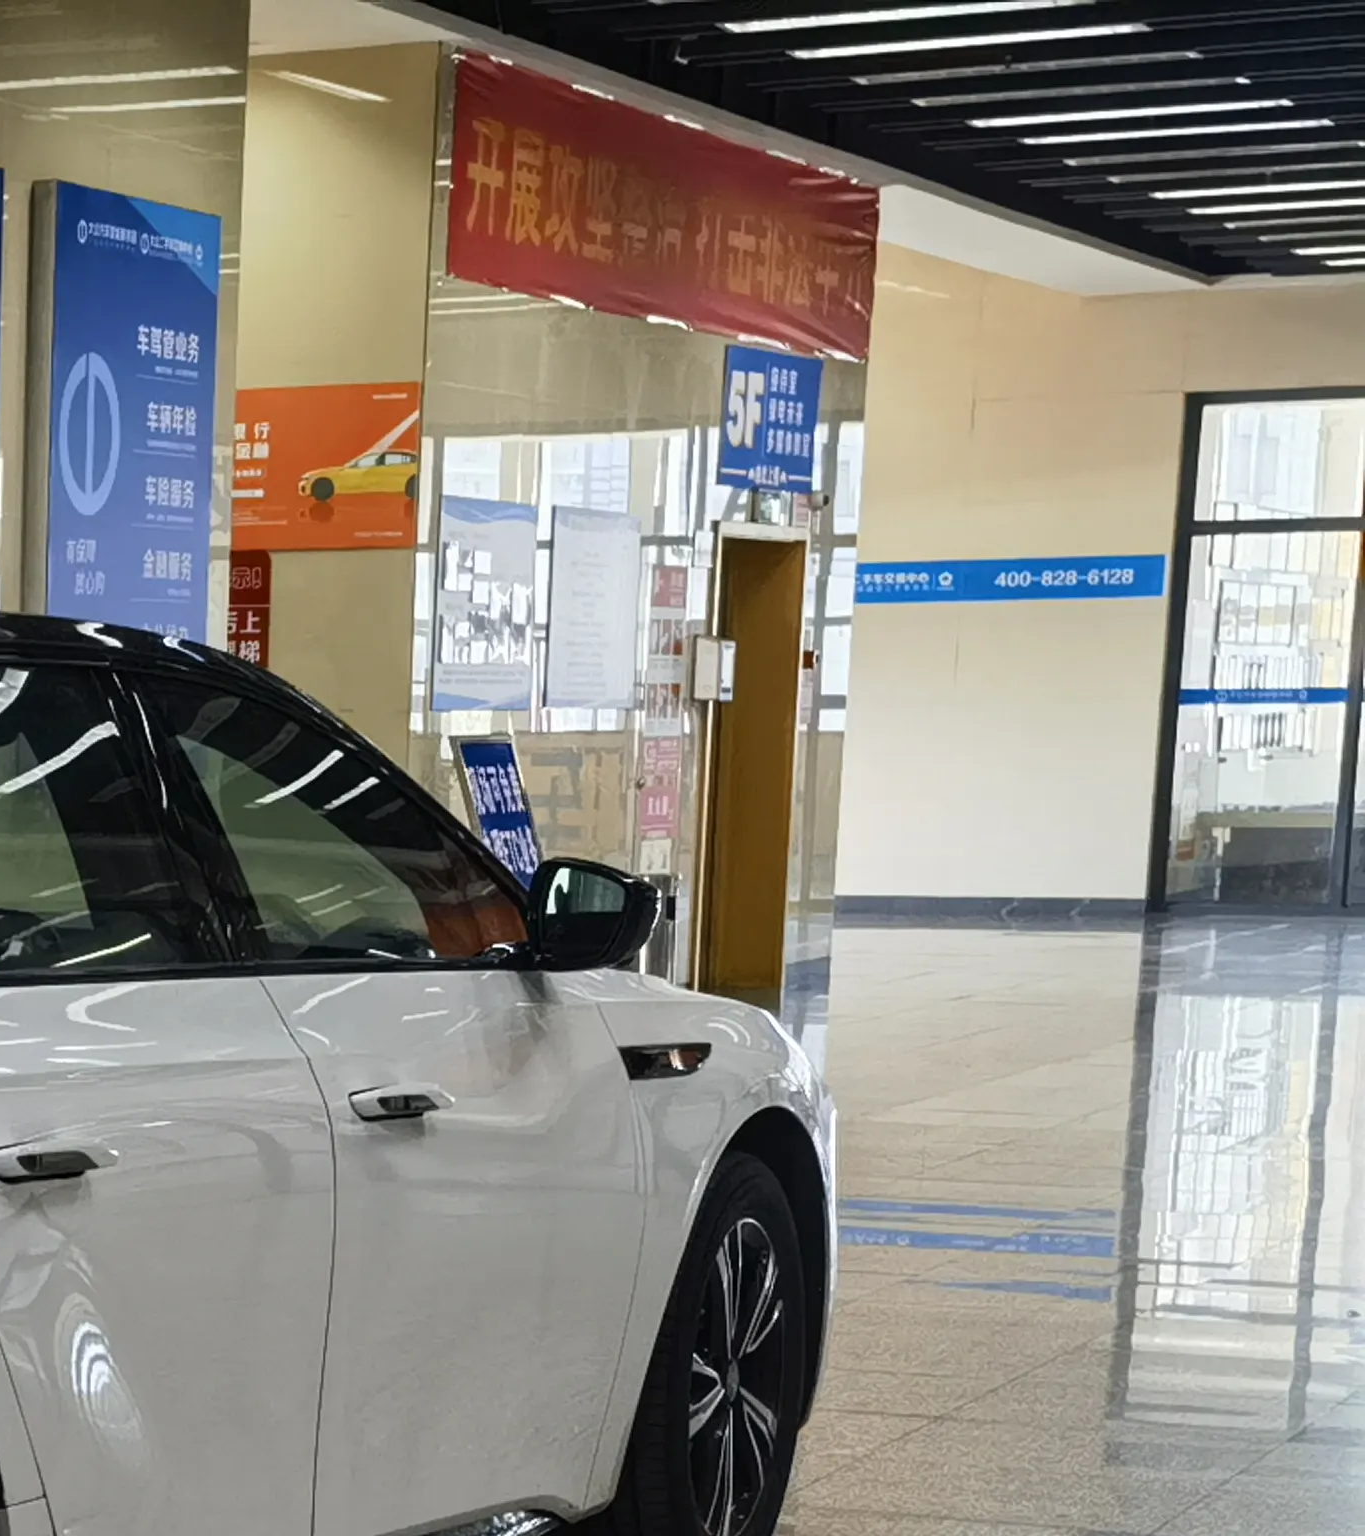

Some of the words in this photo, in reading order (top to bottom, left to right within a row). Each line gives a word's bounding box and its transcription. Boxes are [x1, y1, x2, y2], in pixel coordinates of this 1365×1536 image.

[137, 324, 200, 364] 车驾管业务
[146, 401, 197, 437] 车辆年检
[726, 370, 765, 449] 5F
[145, 475, 194, 508] 车险服务
[143, 548, 192, 582] 金融服务
[994, 567, 1135, 588] 400-828-6128
